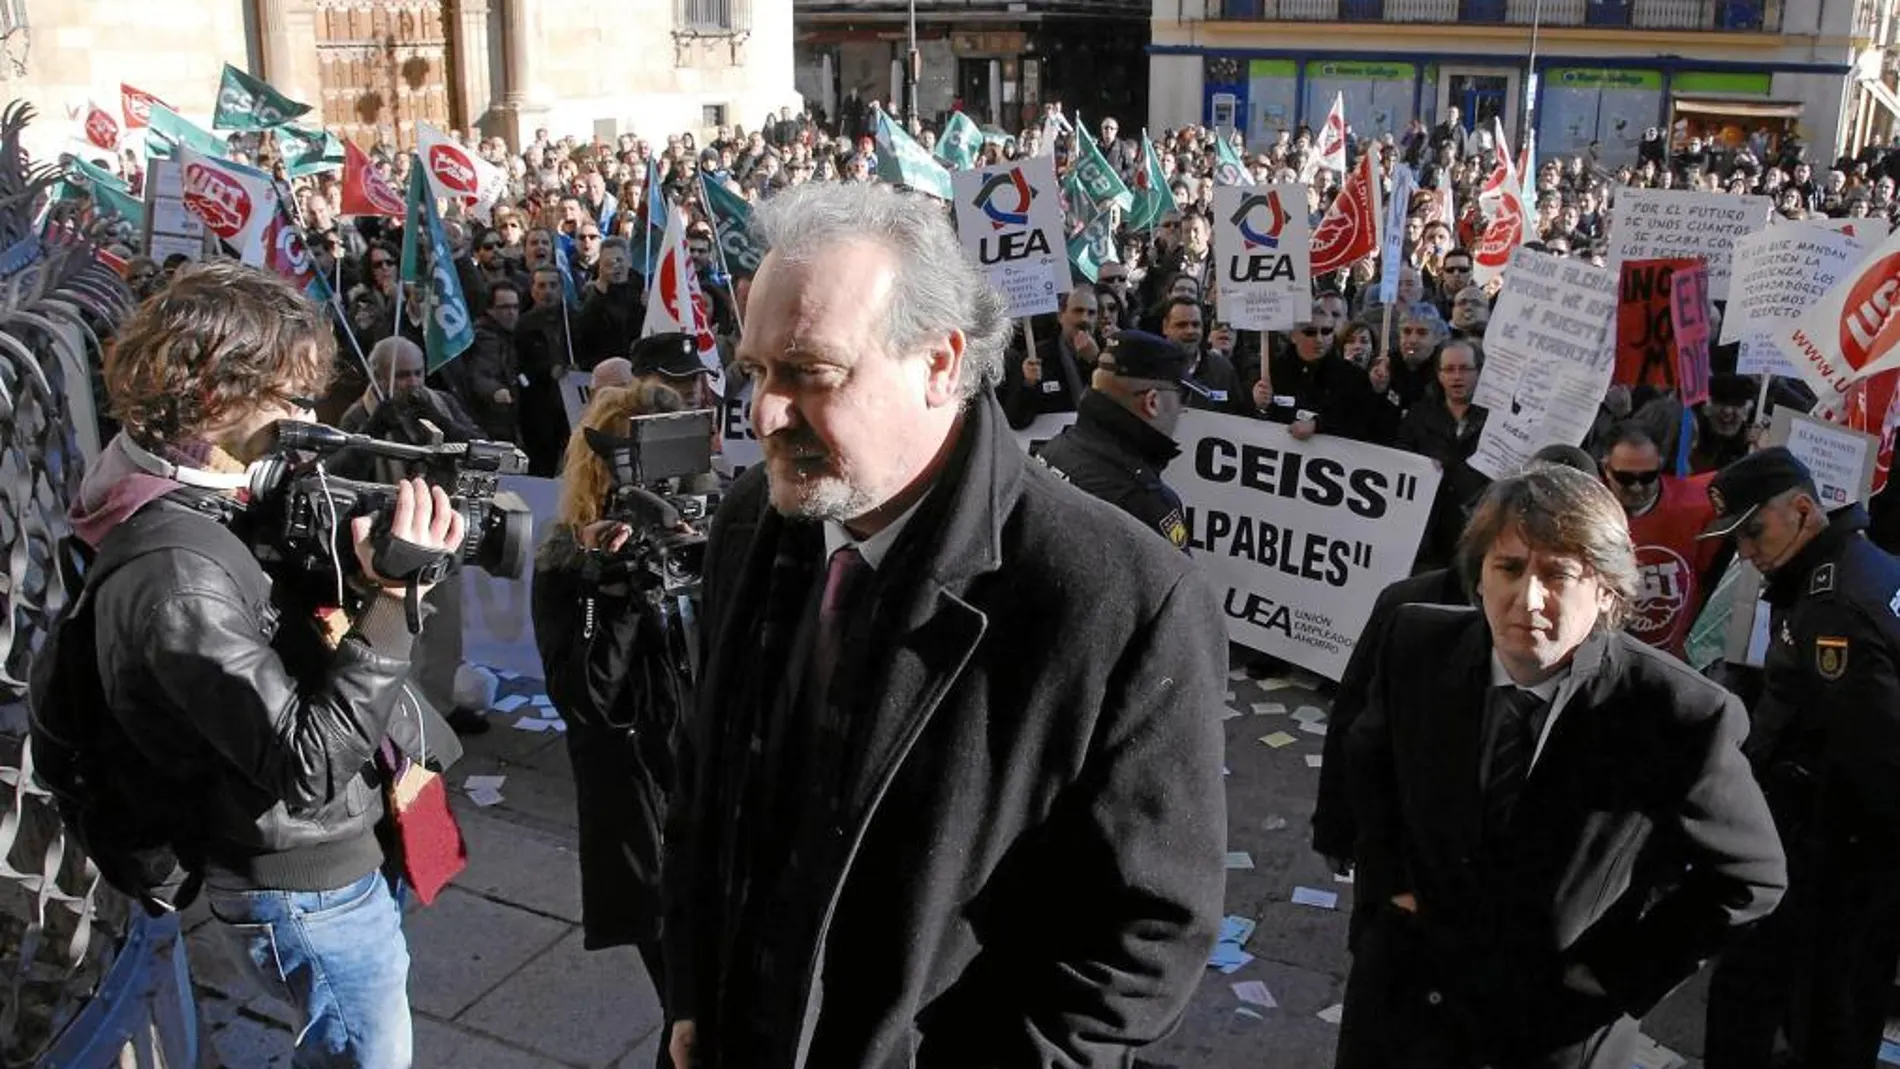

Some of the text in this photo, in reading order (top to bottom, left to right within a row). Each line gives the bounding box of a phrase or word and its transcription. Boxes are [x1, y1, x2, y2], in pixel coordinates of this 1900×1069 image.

[186, 163, 244, 211] UGT
[1632, 202, 1660, 215] POR
[1688, 206, 1745, 221] FUTURO
[1648, 218, 1682, 230] UNOS
[1687, 221, 1751, 236] CUANTOS
[980, 228, 1052, 265] UEA
[1621, 245, 1644, 256] LOS
[1655, 234, 1700, 247] ACABA
[1795, 241, 1847, 261] MANDAN
[1230, 253, 1296, 282] UEA
[1804, 256, 1820, 268] LA
[1813, 271, 1835, 285] LOS
[1195, 436, 1417, 519] CEISS"
[583, 598, 595, 639] Canon
[1223, 587, 1293, 637] UEA
